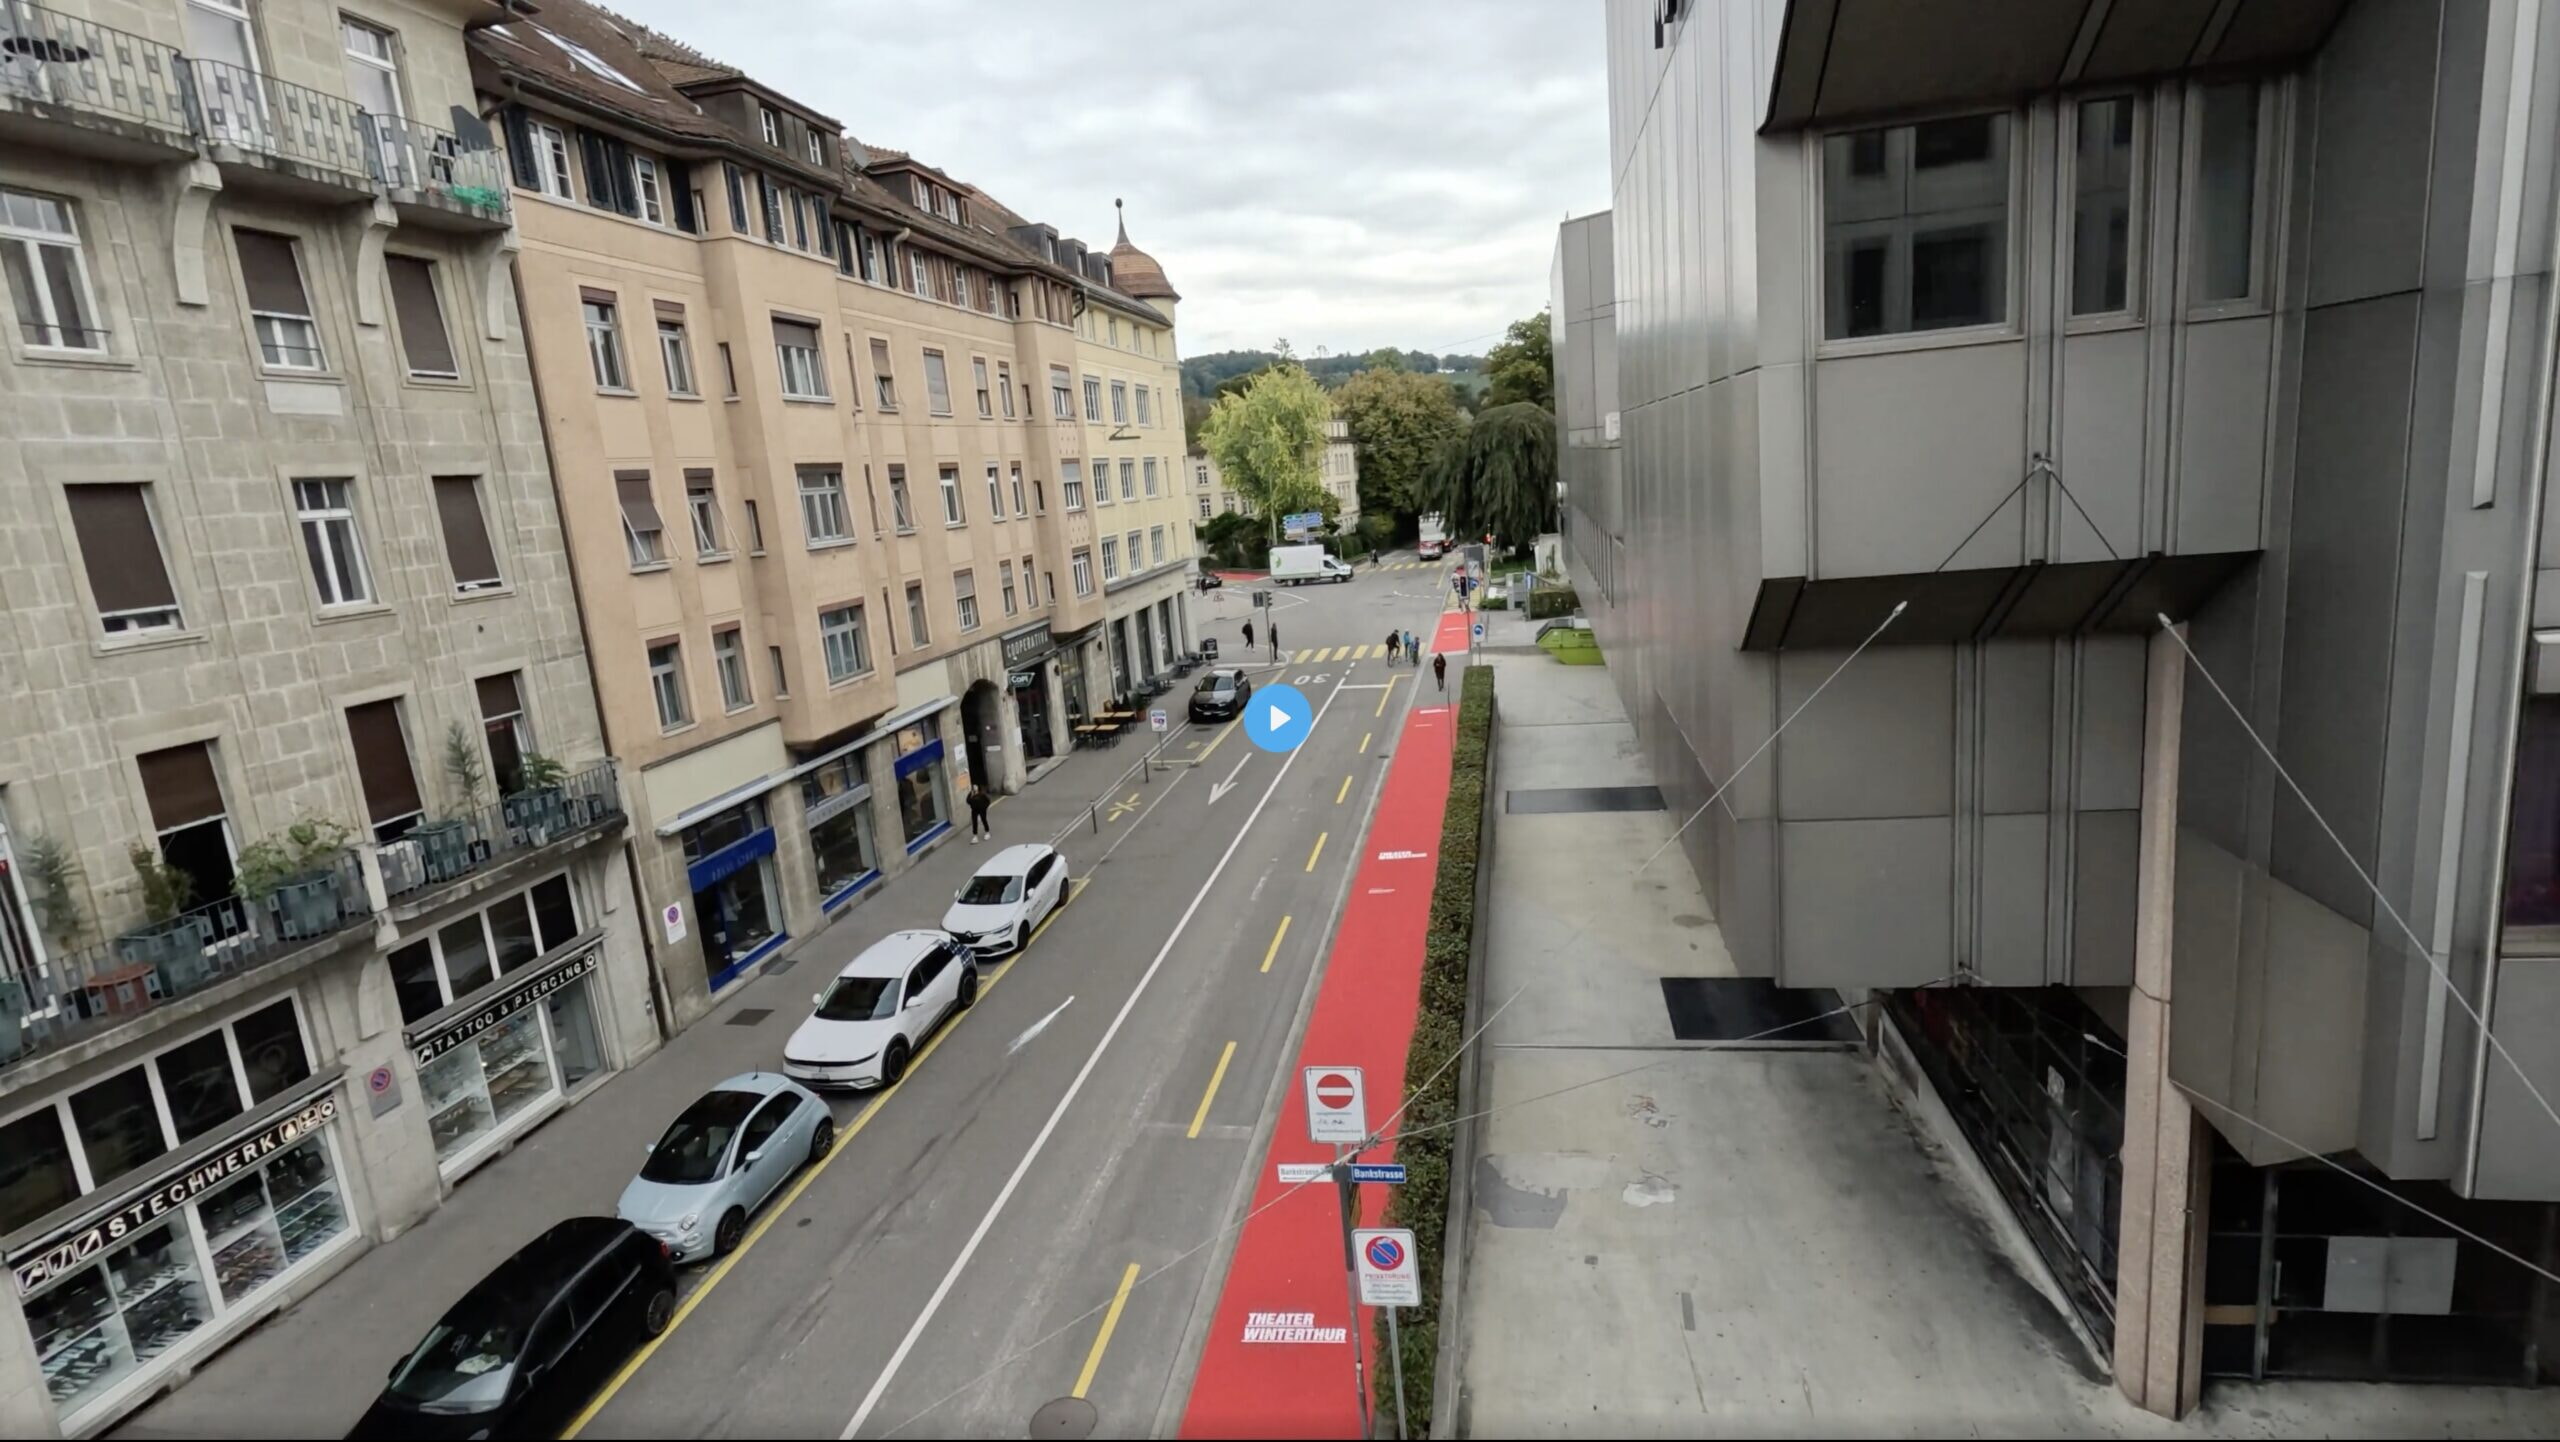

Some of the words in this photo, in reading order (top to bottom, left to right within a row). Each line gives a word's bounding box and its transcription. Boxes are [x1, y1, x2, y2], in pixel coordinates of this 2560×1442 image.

[1007, 630, 1048, 658] COOPERATIVA
[1294, 673, 1331, 685] 30
[435, 1013, 494, 1053] TATTOO
[500, 1003, 509, 1016] &
[514, 962, 582, 1008] PIERCING
[1353, 1168, 1404, 1179] Bankstrasse
[108, 1132, 276, 1238] STECHWERK
[1247, 1312, 1315, 1326] THEATER
[1242, 1327, 1347, 1342] WINTERTHUR
